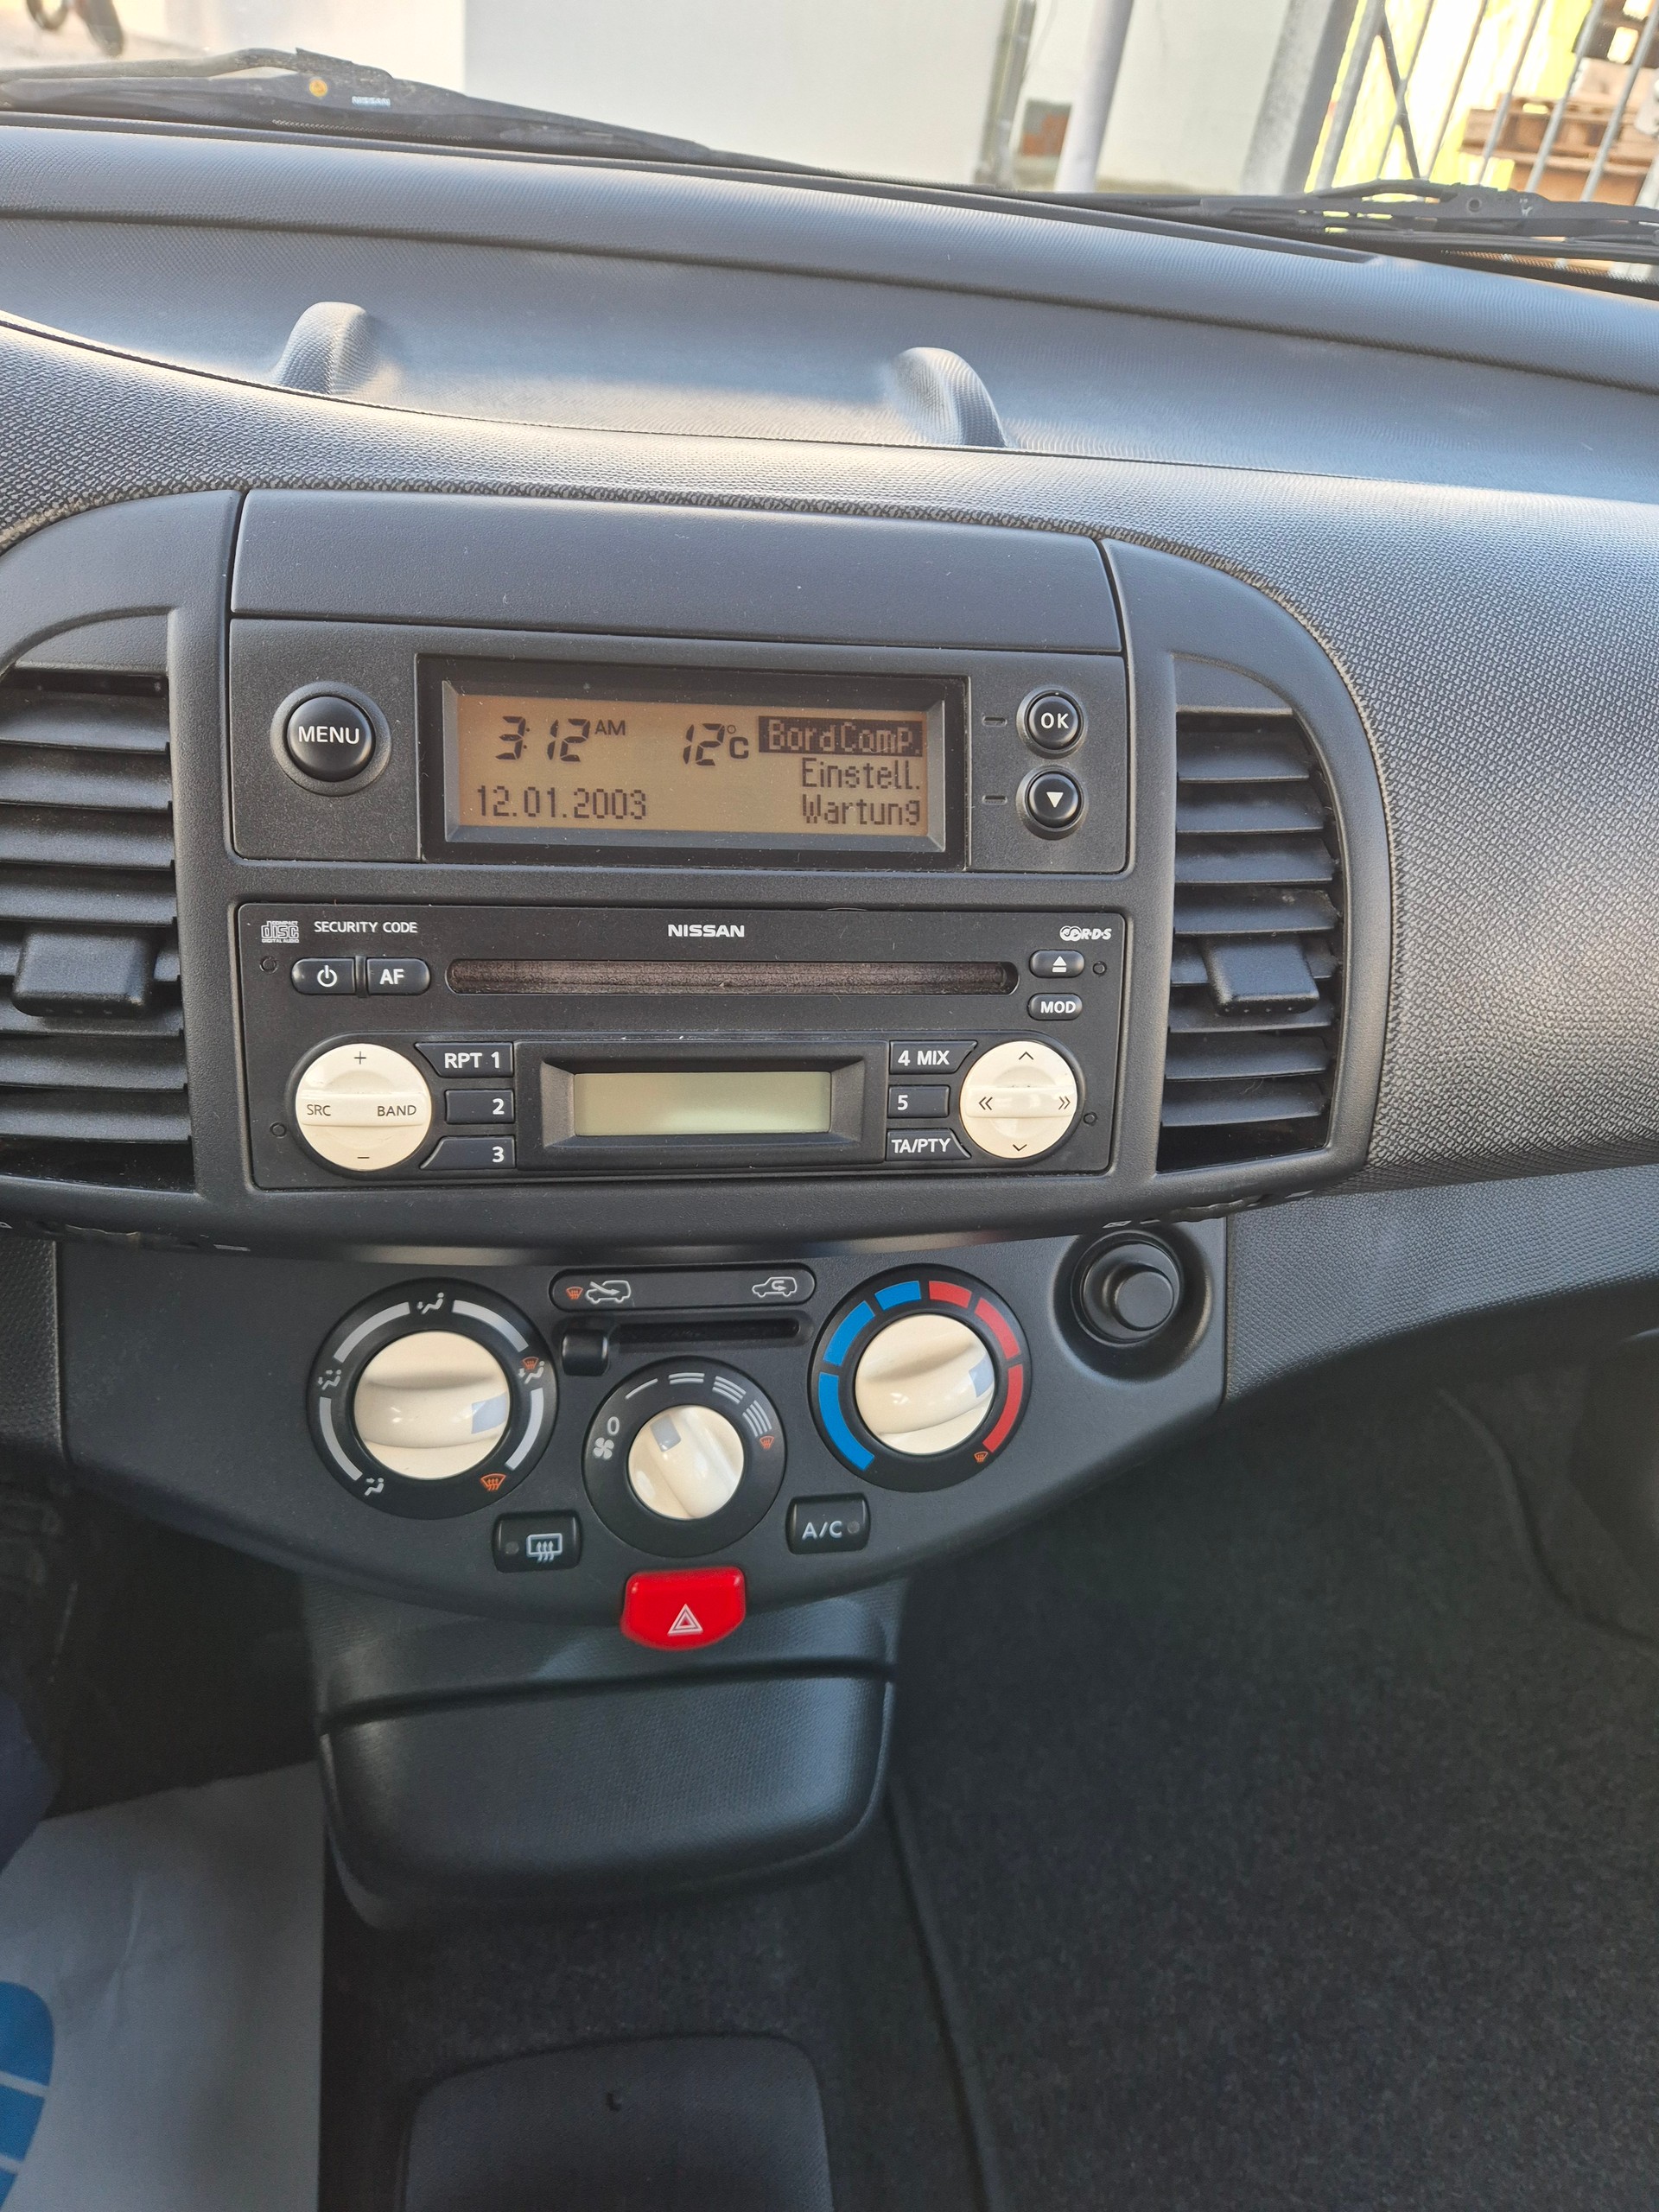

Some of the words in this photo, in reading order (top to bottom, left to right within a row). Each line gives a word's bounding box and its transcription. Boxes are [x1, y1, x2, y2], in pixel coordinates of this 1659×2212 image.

[594, 719, 626, 736] AM
[1040, 713, 1070, 729] OK
[298, 726, 360, 745] MENU
[768, 719, 920, 754] BordComp.
[802, 757, 920, 790] Einstell.
[477, 785, 647, 820] 12.01.2003
[802, 793, 921, 826] Wartung
[314, 921, 378, 933] SECURITY
[382, 921, 418, 933] CODE
[667, 924, 745, 938] NISSAN
[379, 969, 404, 985] AF
[1040, 1001, 1077, 1014] MOD
[444, 1052, 482, 1070] RPT
[491, 1052, 500, 1069] 1
[897, 1050, 911, 1066] 4
[917, 1050, 950, 1065] MIX
[306, 1103, 332, 1117] SRC
[377, 1104, 417, 1117] BAND
[493, 1098, 505, 1115] 2
[897, 1095, 909, 1111] 5
[492, 1146, 505, 1163] 3
[891, 1138, 951, 1155] TA/PTY
[801, 1520, 843, 1541] A/C
